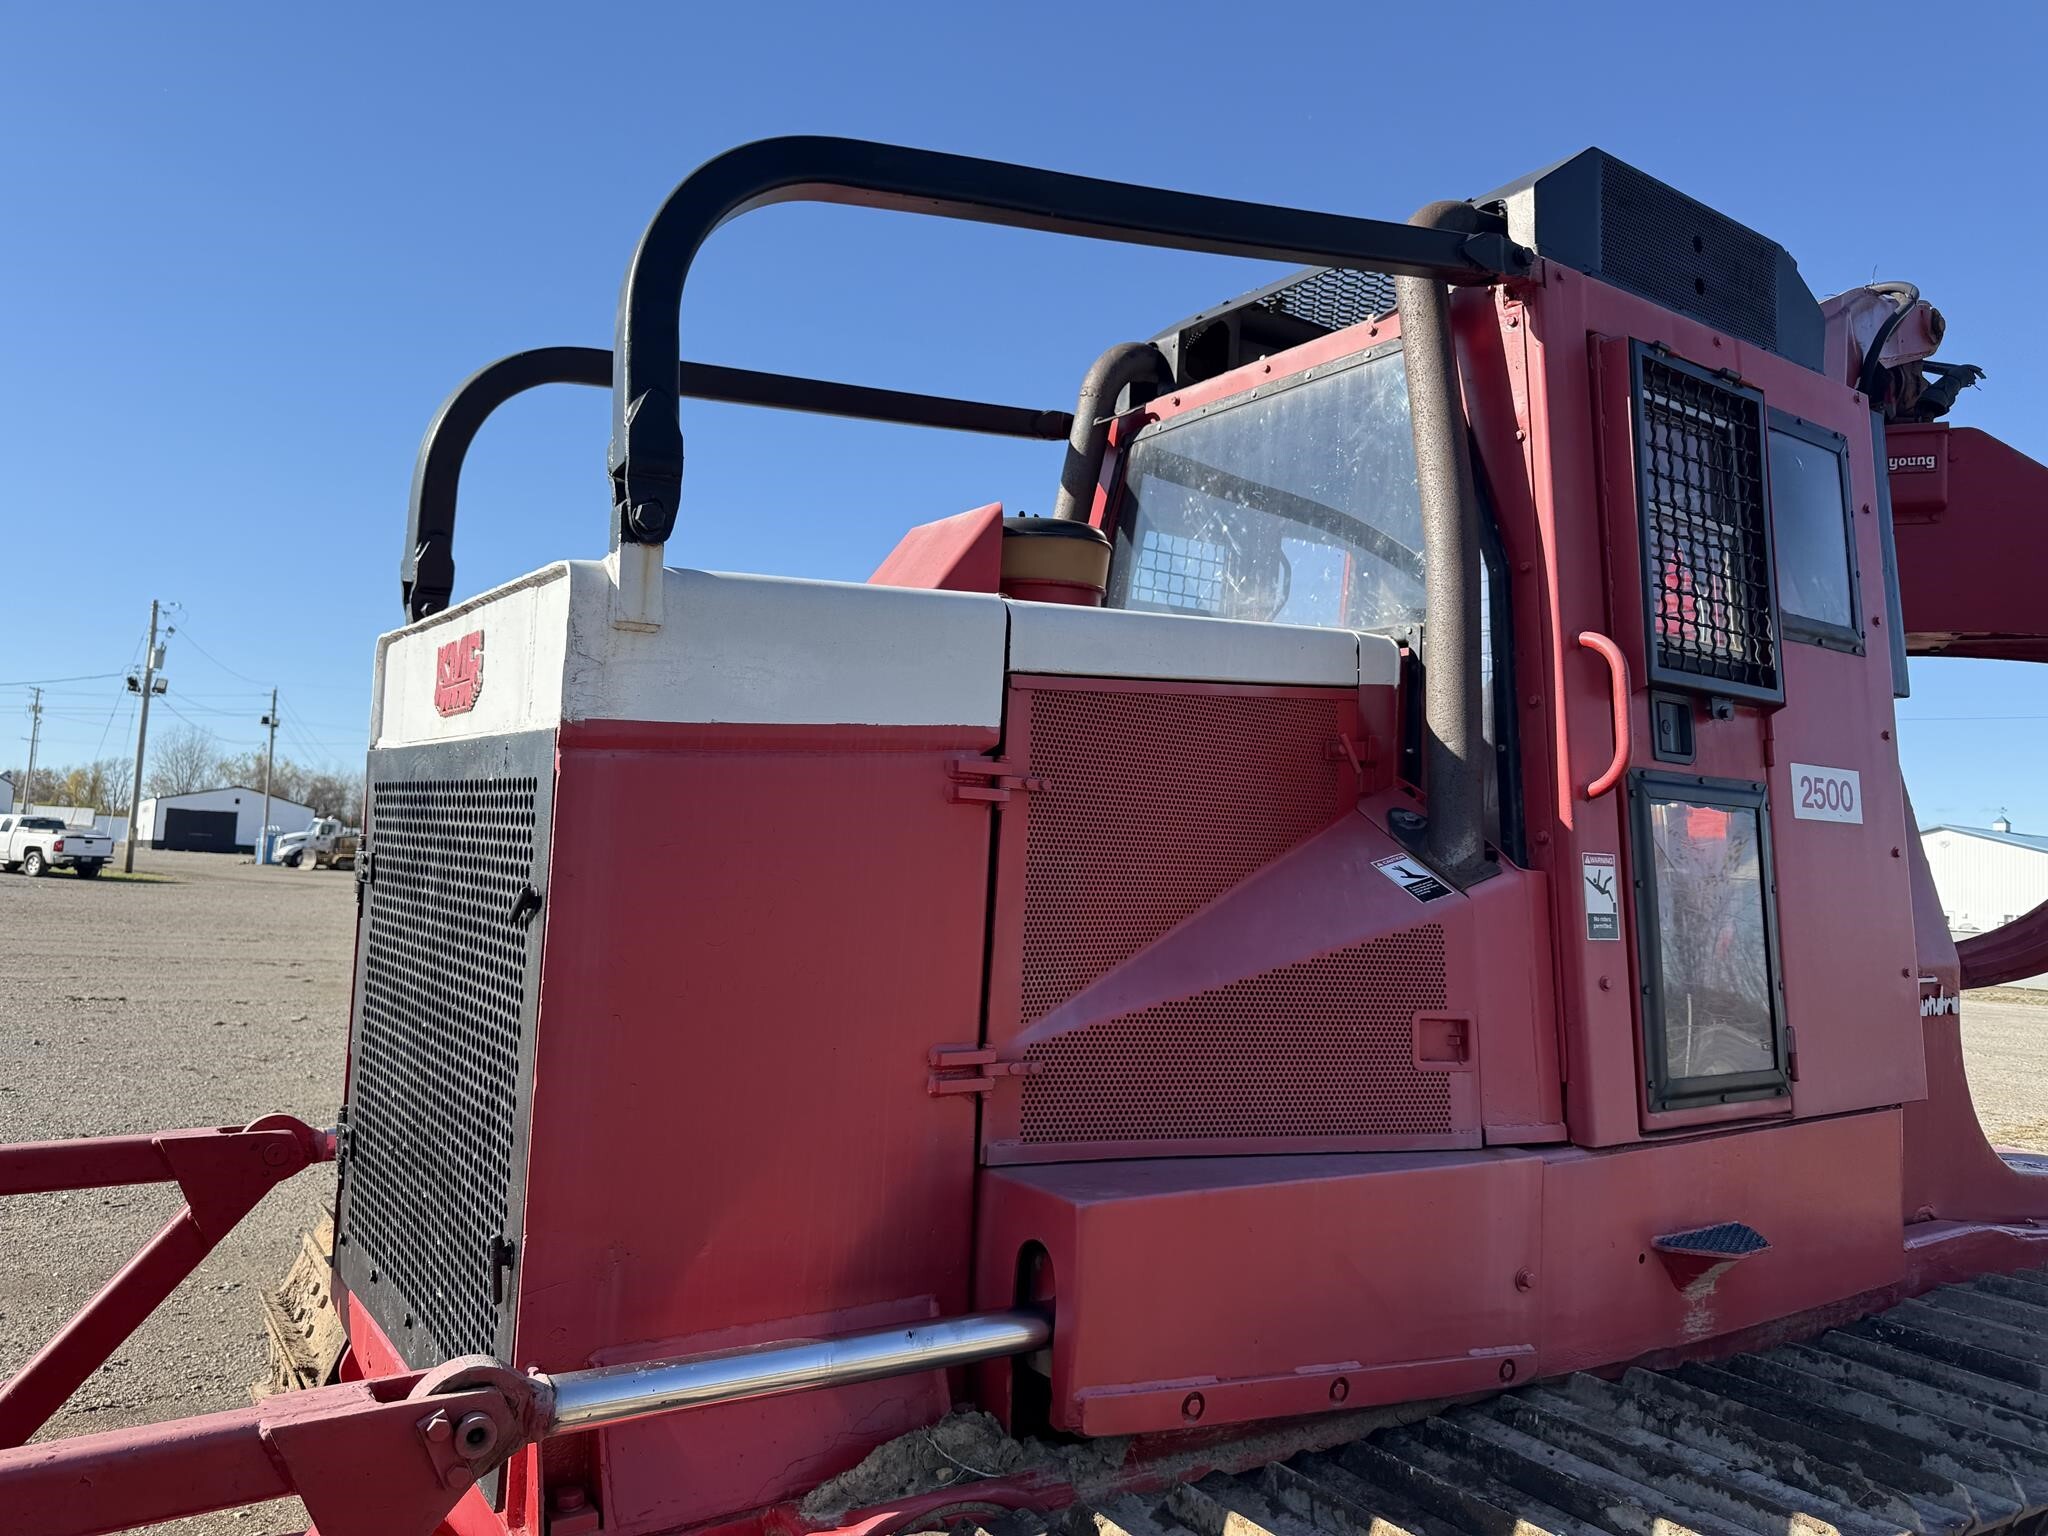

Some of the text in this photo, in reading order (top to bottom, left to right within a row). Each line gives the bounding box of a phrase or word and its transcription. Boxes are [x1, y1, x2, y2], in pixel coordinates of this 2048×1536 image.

[1888, 455, 1936, 471] young
[1800, 775, 1854, 813] 2500
[1589, 856, 1613, 864] WARNING
